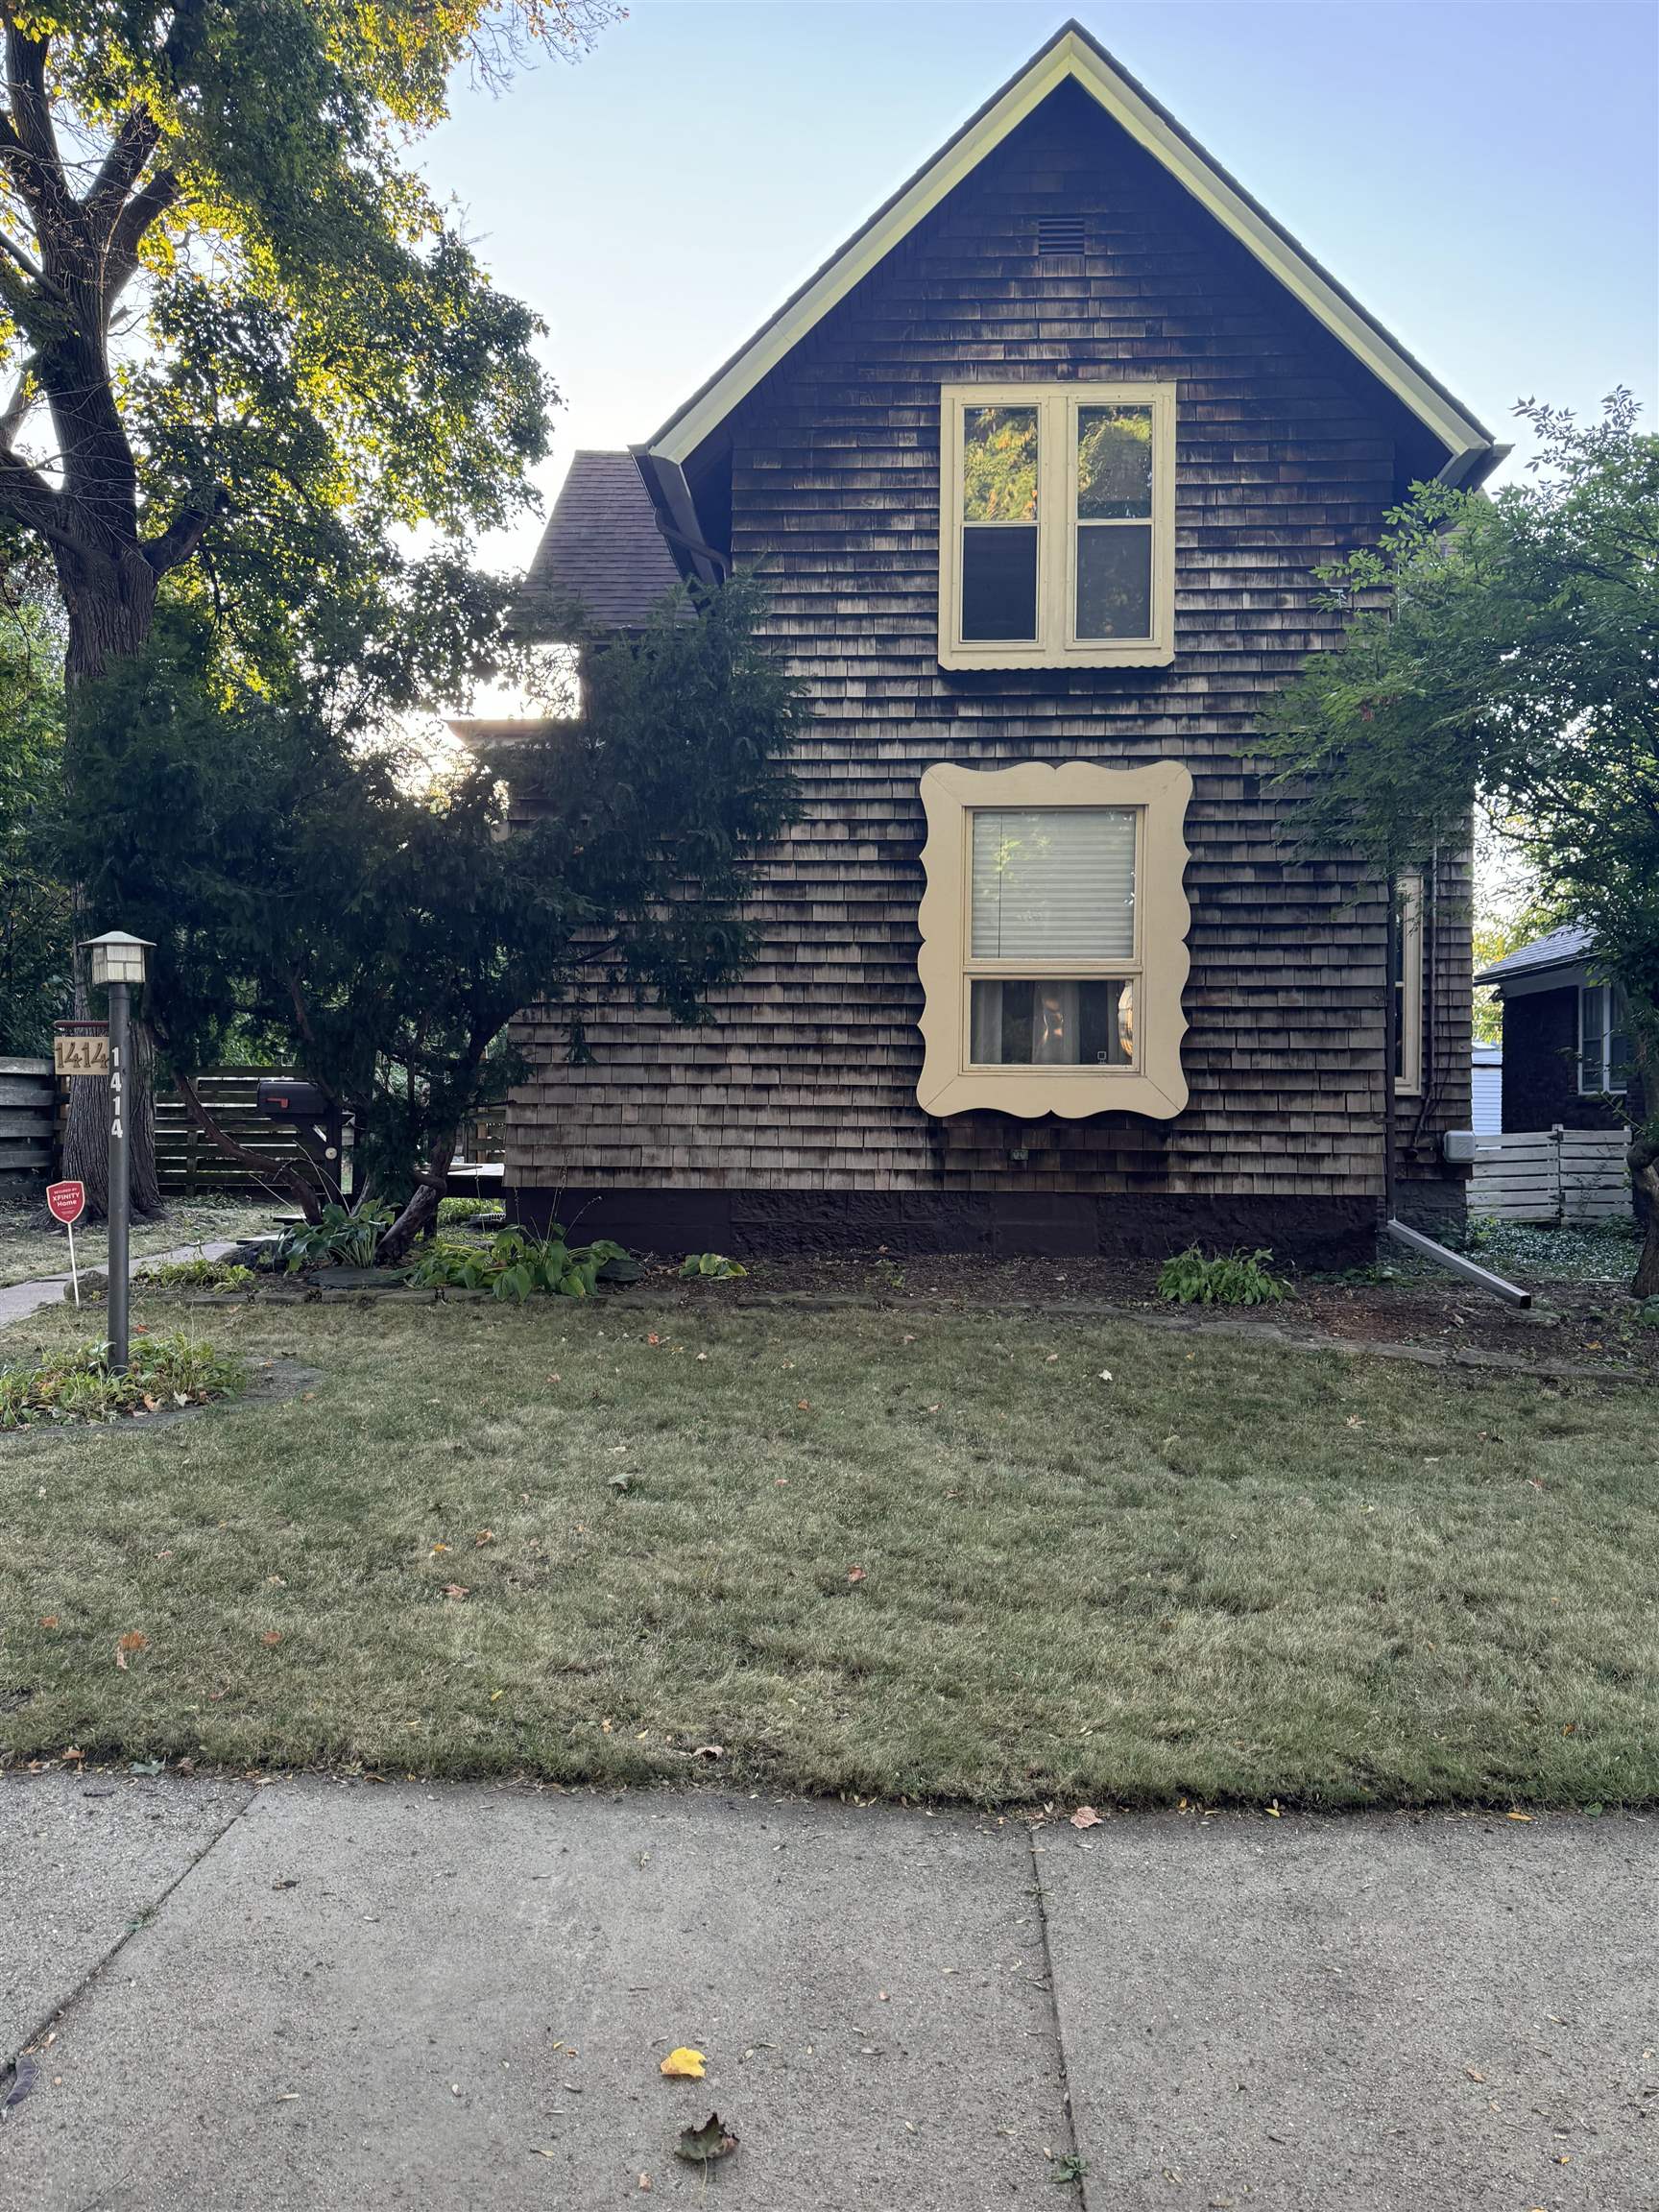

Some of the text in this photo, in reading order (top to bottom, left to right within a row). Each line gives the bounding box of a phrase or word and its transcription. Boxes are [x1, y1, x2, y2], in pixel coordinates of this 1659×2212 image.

[55, 1042, 108, 1069] 1414
[110, 1047, 123, 1139] 1414
[53, 1191, 80, 1201] XFINITY
